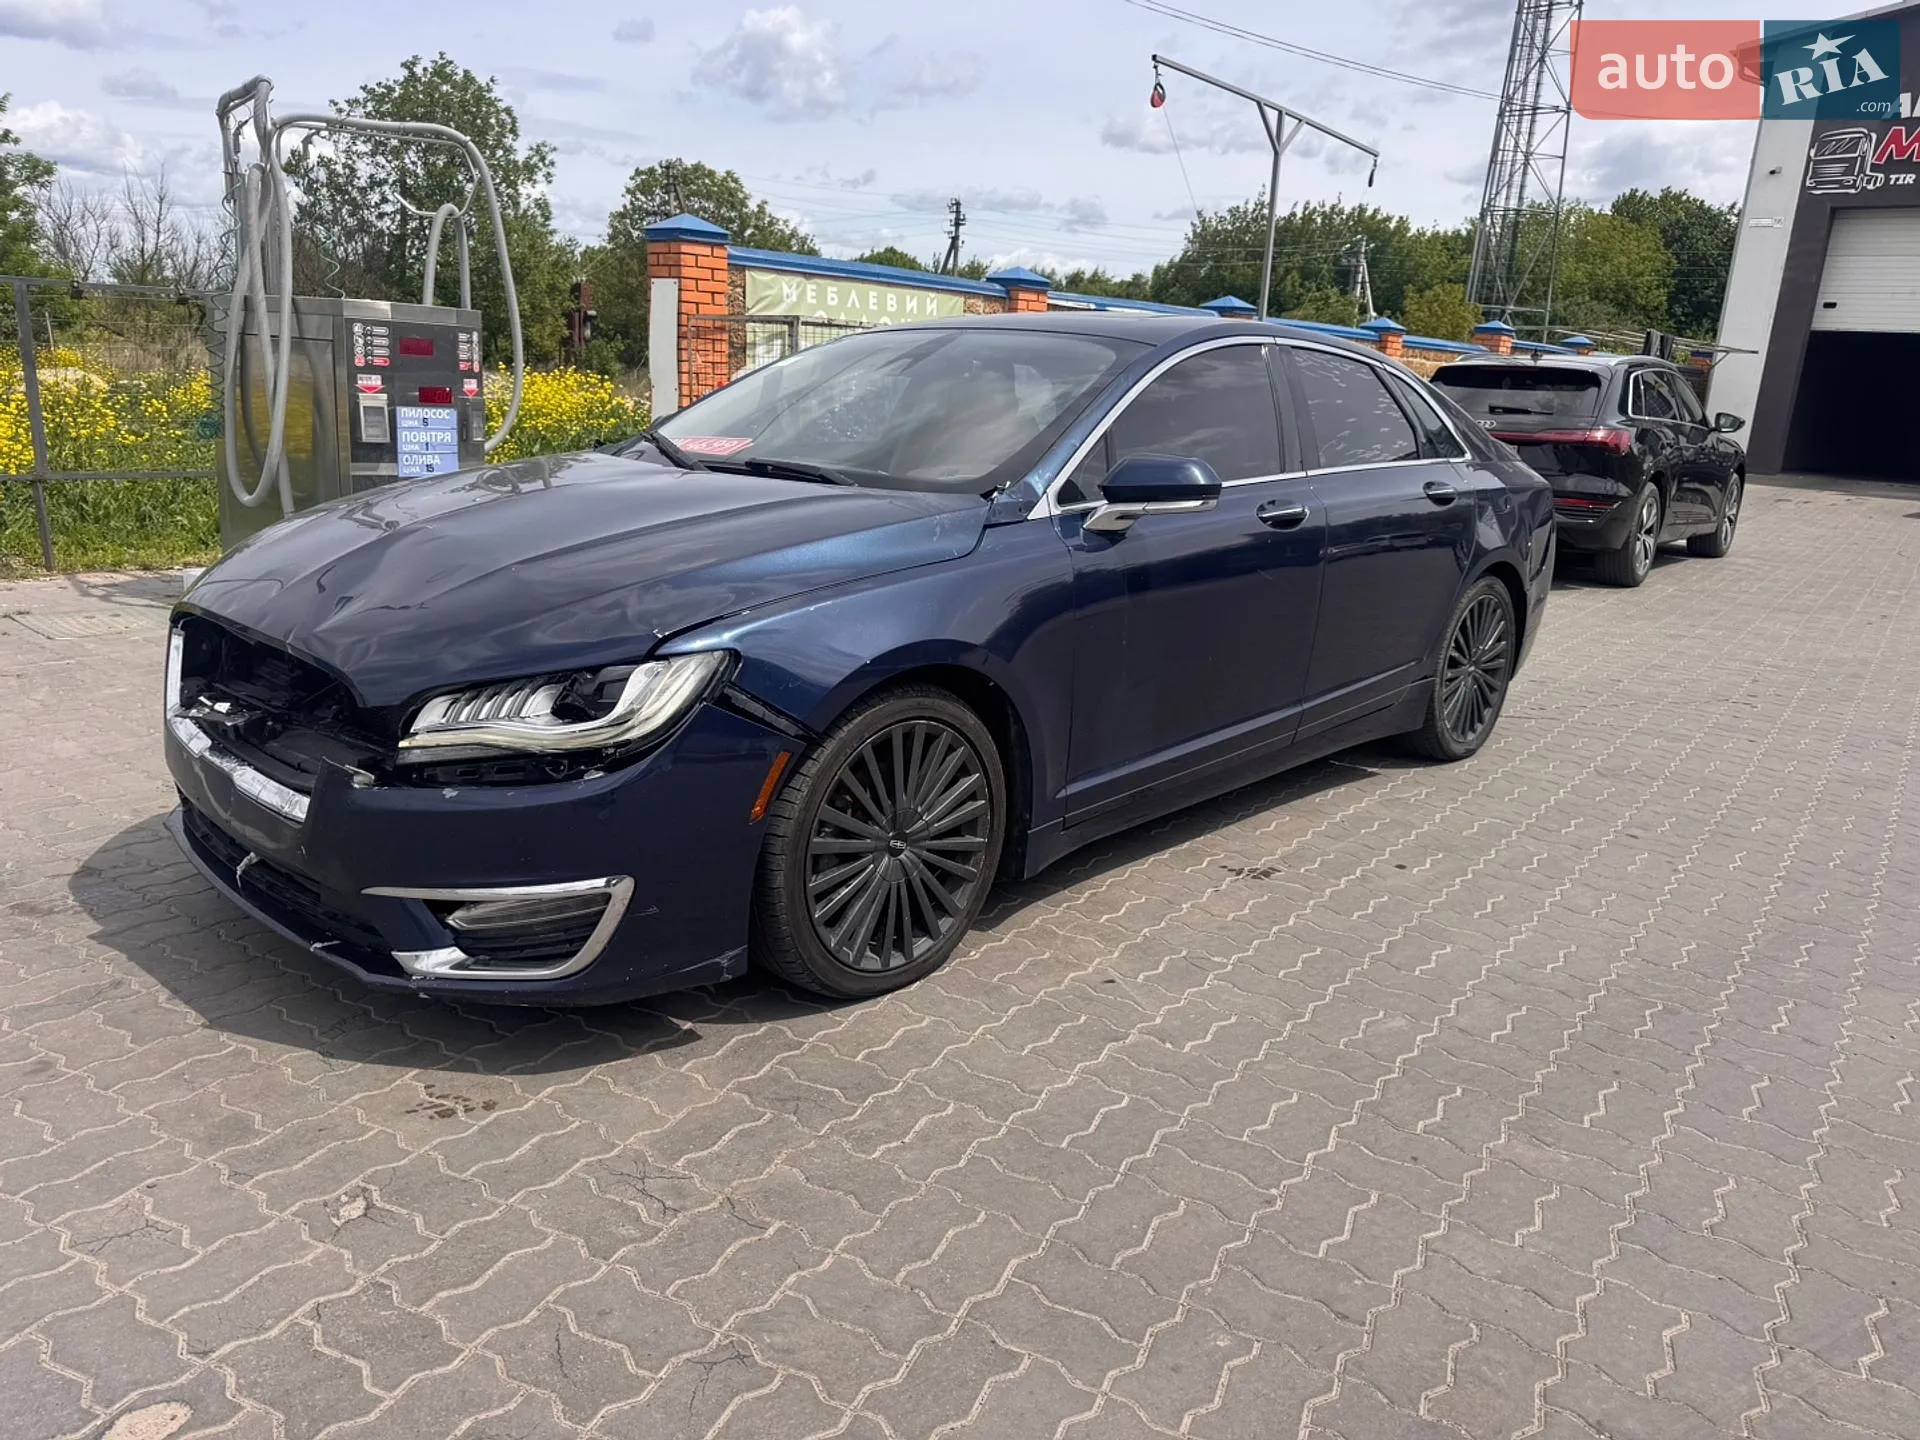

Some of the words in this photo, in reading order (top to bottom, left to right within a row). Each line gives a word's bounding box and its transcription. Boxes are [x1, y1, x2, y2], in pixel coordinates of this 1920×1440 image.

[1889, 173, 1916, 185] TIR
[782, 281, 938, 316] МЕБЛЕВИЙ
[401, 408, 451, 419] ПИЛОСОС
[402, 431, 452, 443] ПОВІТРЯ
[402, 454, 441, 465] ОЛИВА
